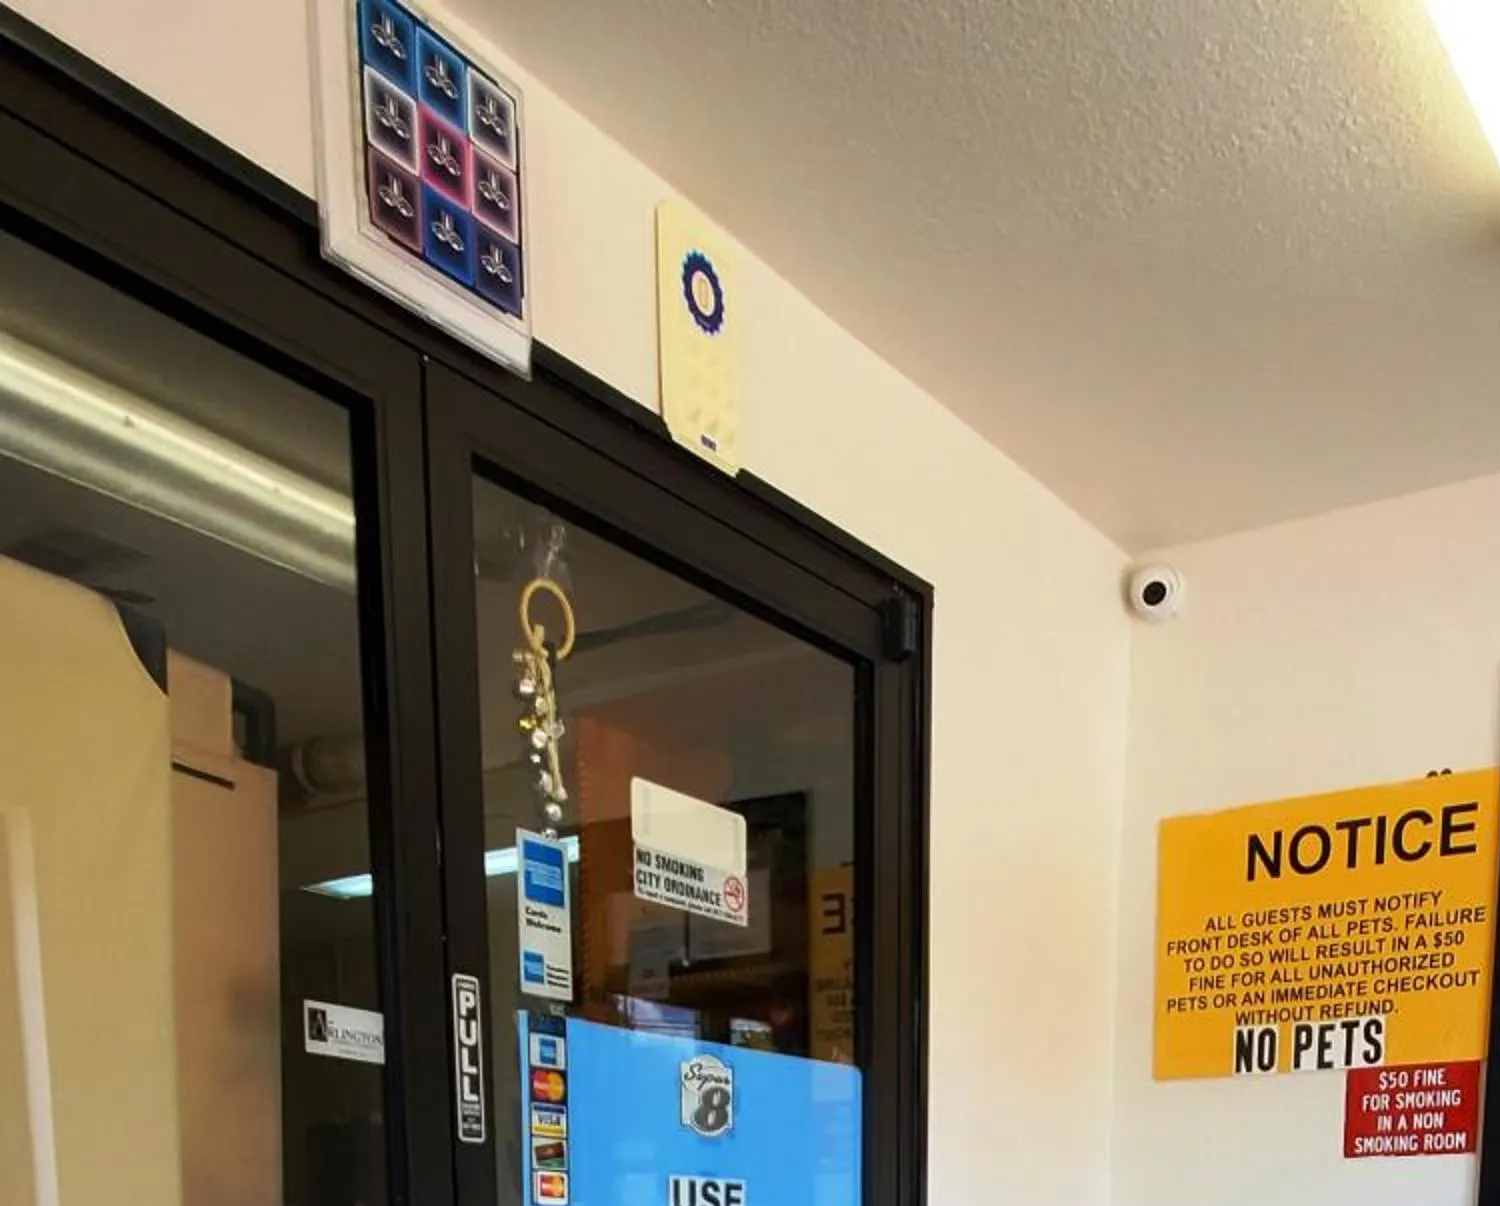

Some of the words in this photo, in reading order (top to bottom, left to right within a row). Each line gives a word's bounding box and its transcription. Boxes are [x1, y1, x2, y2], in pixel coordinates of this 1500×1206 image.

[1247, 802, 1479, 882] NOTICE
[636, 848, 652, 867] NO
[655, 854, 705, 883] SMOKING
[636, 869, 661, 889] CITY
[664, 877, 722, 907] ORDINANCE
[1205, 916, 1236, 932] ALL
[1242, 906, 1312, 927] GUESTS
[1317, 899, 1368, 918] MUST
[1374, 890, 1443, 912] NOTIFY
[1167, 937, 1221, 956] FRONT
[1227, 931, 1273, 948] DESK
[1279, 927, 1303, 943] OF
[1307, 925, 1340, 941] ALL
[1346, 919, 1398, 936] PETS.
[1405, 906, 1486, 929] FAILURE
[1184, 958, 1206, 973] TO
[1211, 955, 1236, 970] DO
[1240, 952, 1264, 967] SO
[1269, 948, 1311, 965] WILL
[1315, 938, 1386, 960] RESULT
[1391, 934, 1411, 951] IN
[1414, 933, 1428, 950] A
[1433, 929, 1466, 949] $50
[1189, 975, 1226, 992] FINE
[1231, 970, 1265, 988] FOR
[1270, 968, 1304, 984] ALL
[1309, 951, 1456, 981] UNAUTHORIZED
[1167, 995, 1208, 1013] PETS
[1213, 992, 1237, 1009] OR
[1241, 990, 1265, 1007] AN
[1271, 983, 1368, 1004] IMMEDIATE
[1373, 970, 1481, 994] CHECKOUT
[1235, 1005, 1314, 1026] WITHOUT
[1319, 999, 1399, 1020] REFUND.
[459, 991, 480, 1102] PULL
[1235, 1027, 1277, 1073] NO
[1294, 1018, 1383, 1070] PETS
[684, 1063, 731, 1091] Super
[1379, 1072, 1408, 1089] $50
[1414, 1067, 1446, 1086] FINE
[538, 1112, 561, 1126] VISA
[692, 1087, 732, 1132] 8
[1362, 1095, 1389, 1112] FOR
[1394, 1089, 1461, 1110] SMOKING
[1377, 1115, 1392, 1131] IN
[1398, 1114, 1408, 1129] A
[1413, 1112, 1444, 1128] NON
[1354, 1136, 1418, 1153] SMOKING
[1424, 1133, 1466, 1151] ROOM
